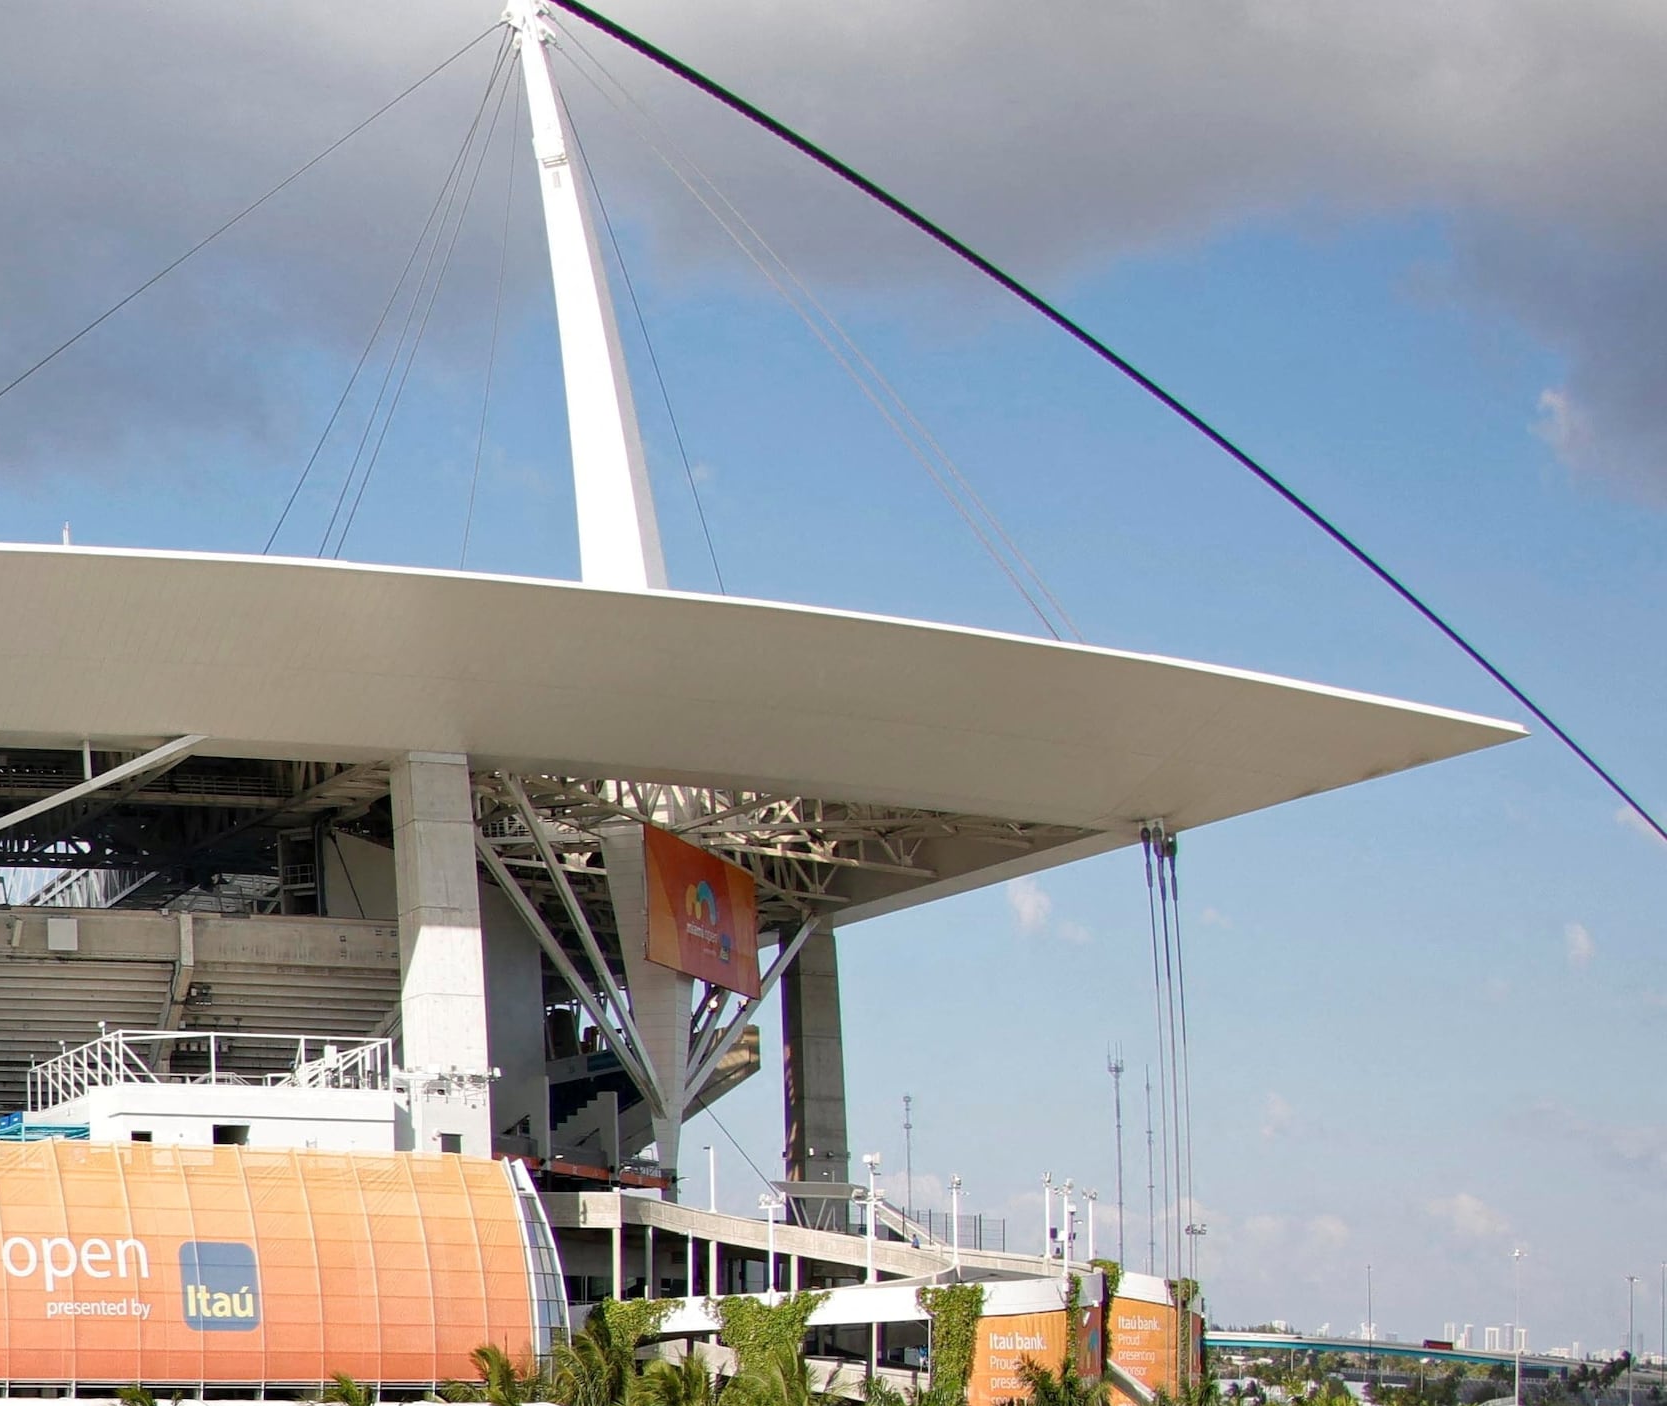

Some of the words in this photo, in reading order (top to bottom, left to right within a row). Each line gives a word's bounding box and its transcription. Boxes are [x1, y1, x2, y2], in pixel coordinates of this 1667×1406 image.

[1, 1234, 150, 1292] open
[46, 1297, 126, 1320] presented
[129, 1298, 152, 1321] by
[185, 1284, 255, 1320] Itaú
[1117, 1315, 1136, 1330] Itaú
[988, 1332, 1014, 1350] Itaú
[1015, 1331, 1047, 1350] bank.
[1117, 1333, 1140, 1346] Proud
